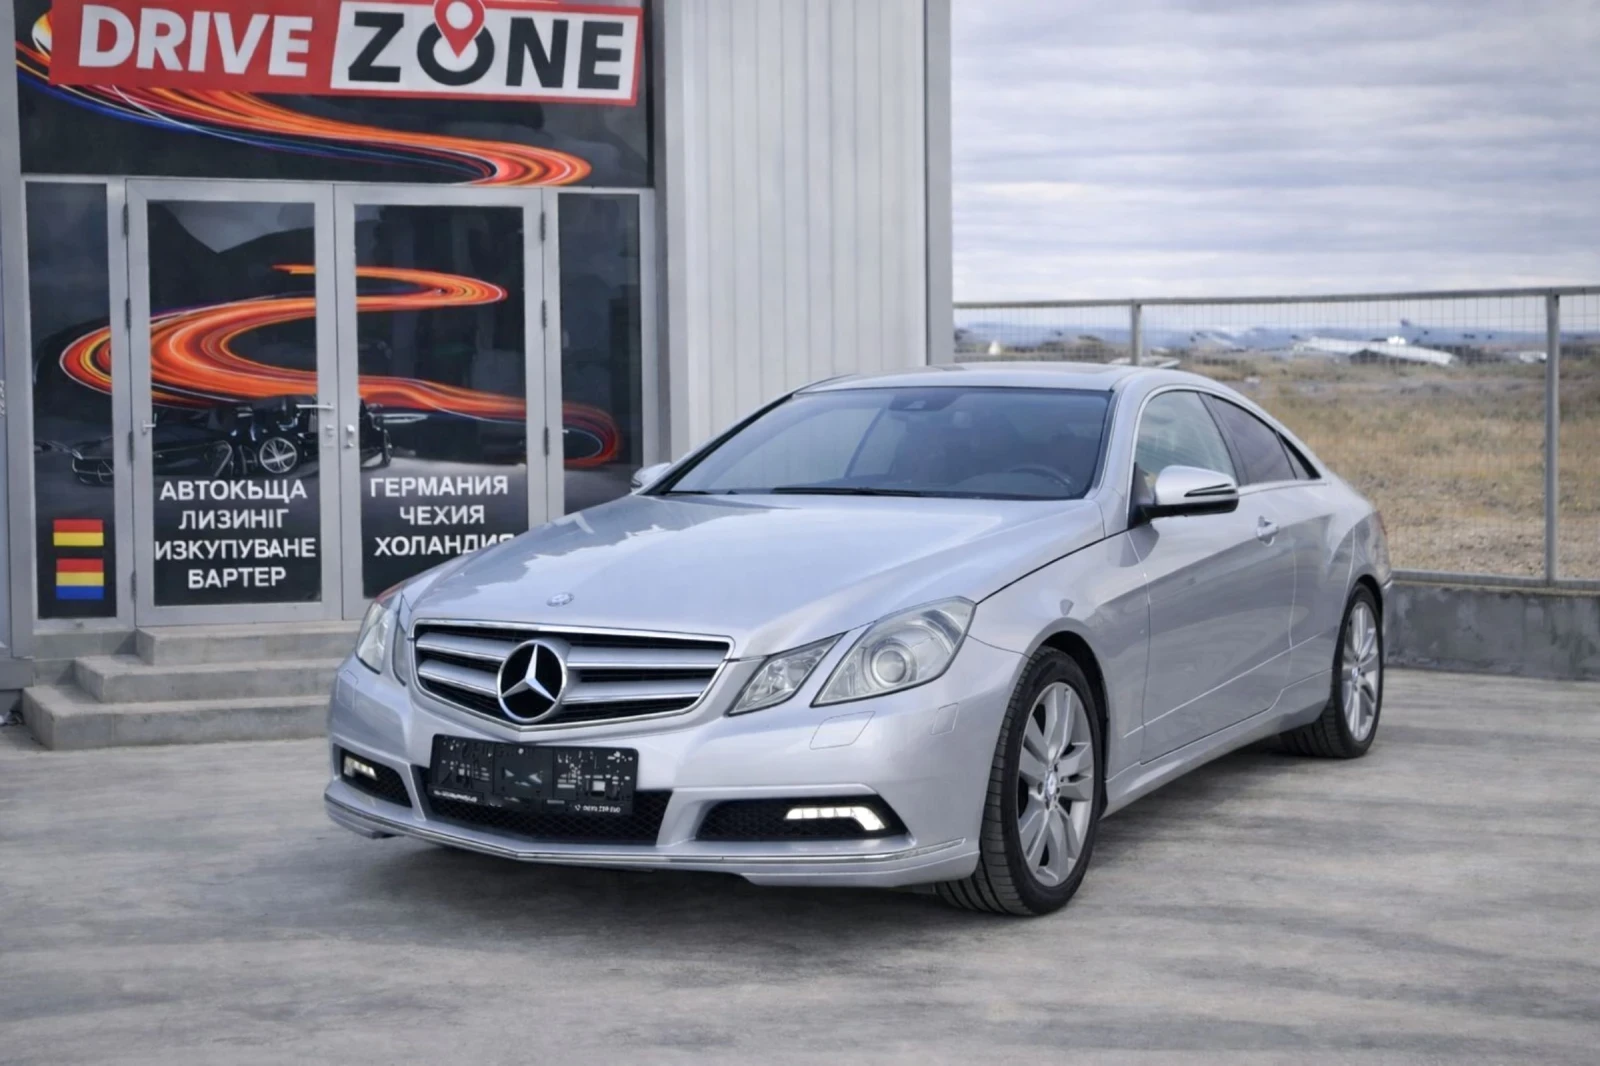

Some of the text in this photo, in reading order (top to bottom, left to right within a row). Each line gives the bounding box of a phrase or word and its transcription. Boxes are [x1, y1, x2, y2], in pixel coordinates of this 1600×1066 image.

[79, 6, 625, 90] DRIVE ZONE
[370, 475, 508, 497] ГЕРМАНИЯ
[399, 504, 485, 525] ЧЕХИЯ
[187, 566, 287, 590] БАРТЕР
